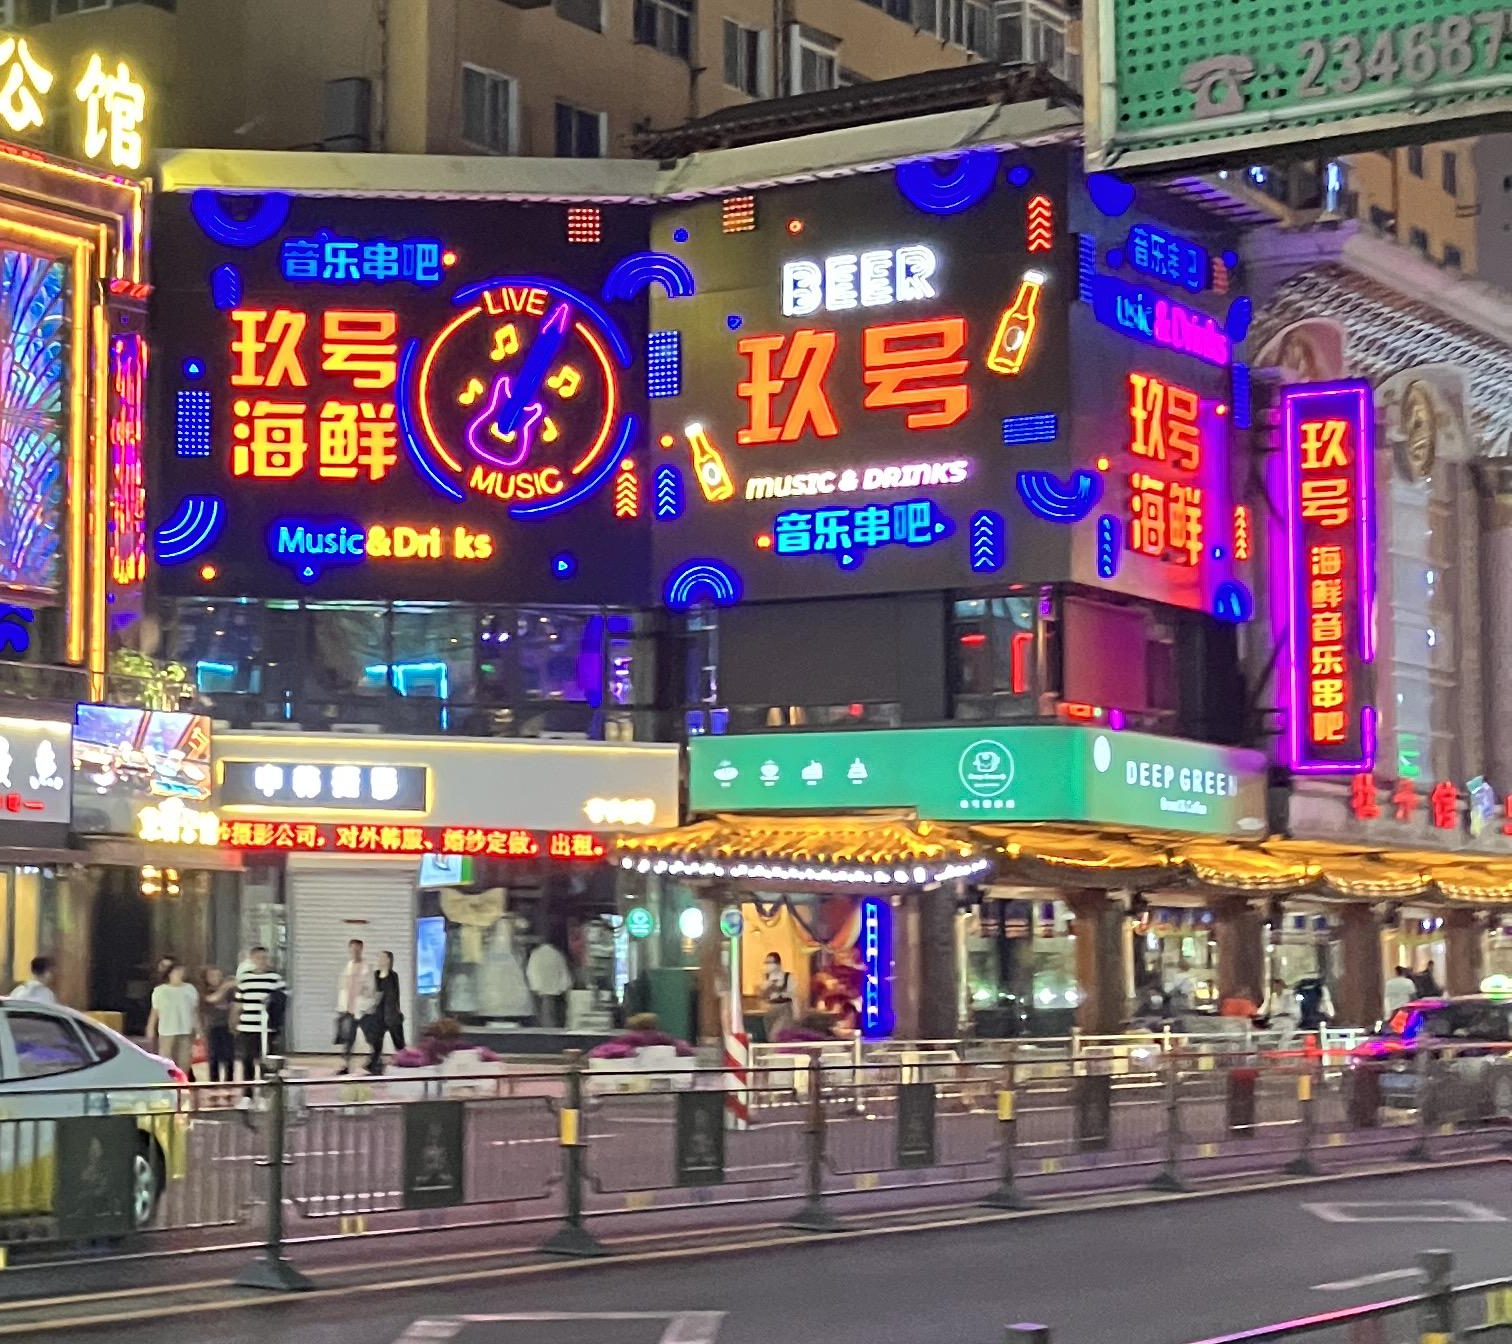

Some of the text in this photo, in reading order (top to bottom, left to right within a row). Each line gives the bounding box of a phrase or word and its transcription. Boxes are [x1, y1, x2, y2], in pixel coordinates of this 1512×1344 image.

[1297, 8, 1512, 99] 234687
[283, 240, 440, 282] 音乐串吧
[782, 245, 937, 317] BEER
[482, 287, 549, 316] LIVE
[230, 309, 398, 390] 玖号
[736, 316, 971, 446] 玖号
[230, 400, 398, 481] 海鲜
[1129, 372, 1200, 471] 玖号
[469, 464, 564, 499] MUSIC
[744, 460, 969, 501] MUSIC & DRINKS
[776, 500, 932, 554] 音乐串吧
[1130, 471, 1203, 567] 海鲜
[1300, 419, 1349, 744] 玖号 海鲜音乐串吧
[1125, 760, 1238, 798] DEEP GREEN
